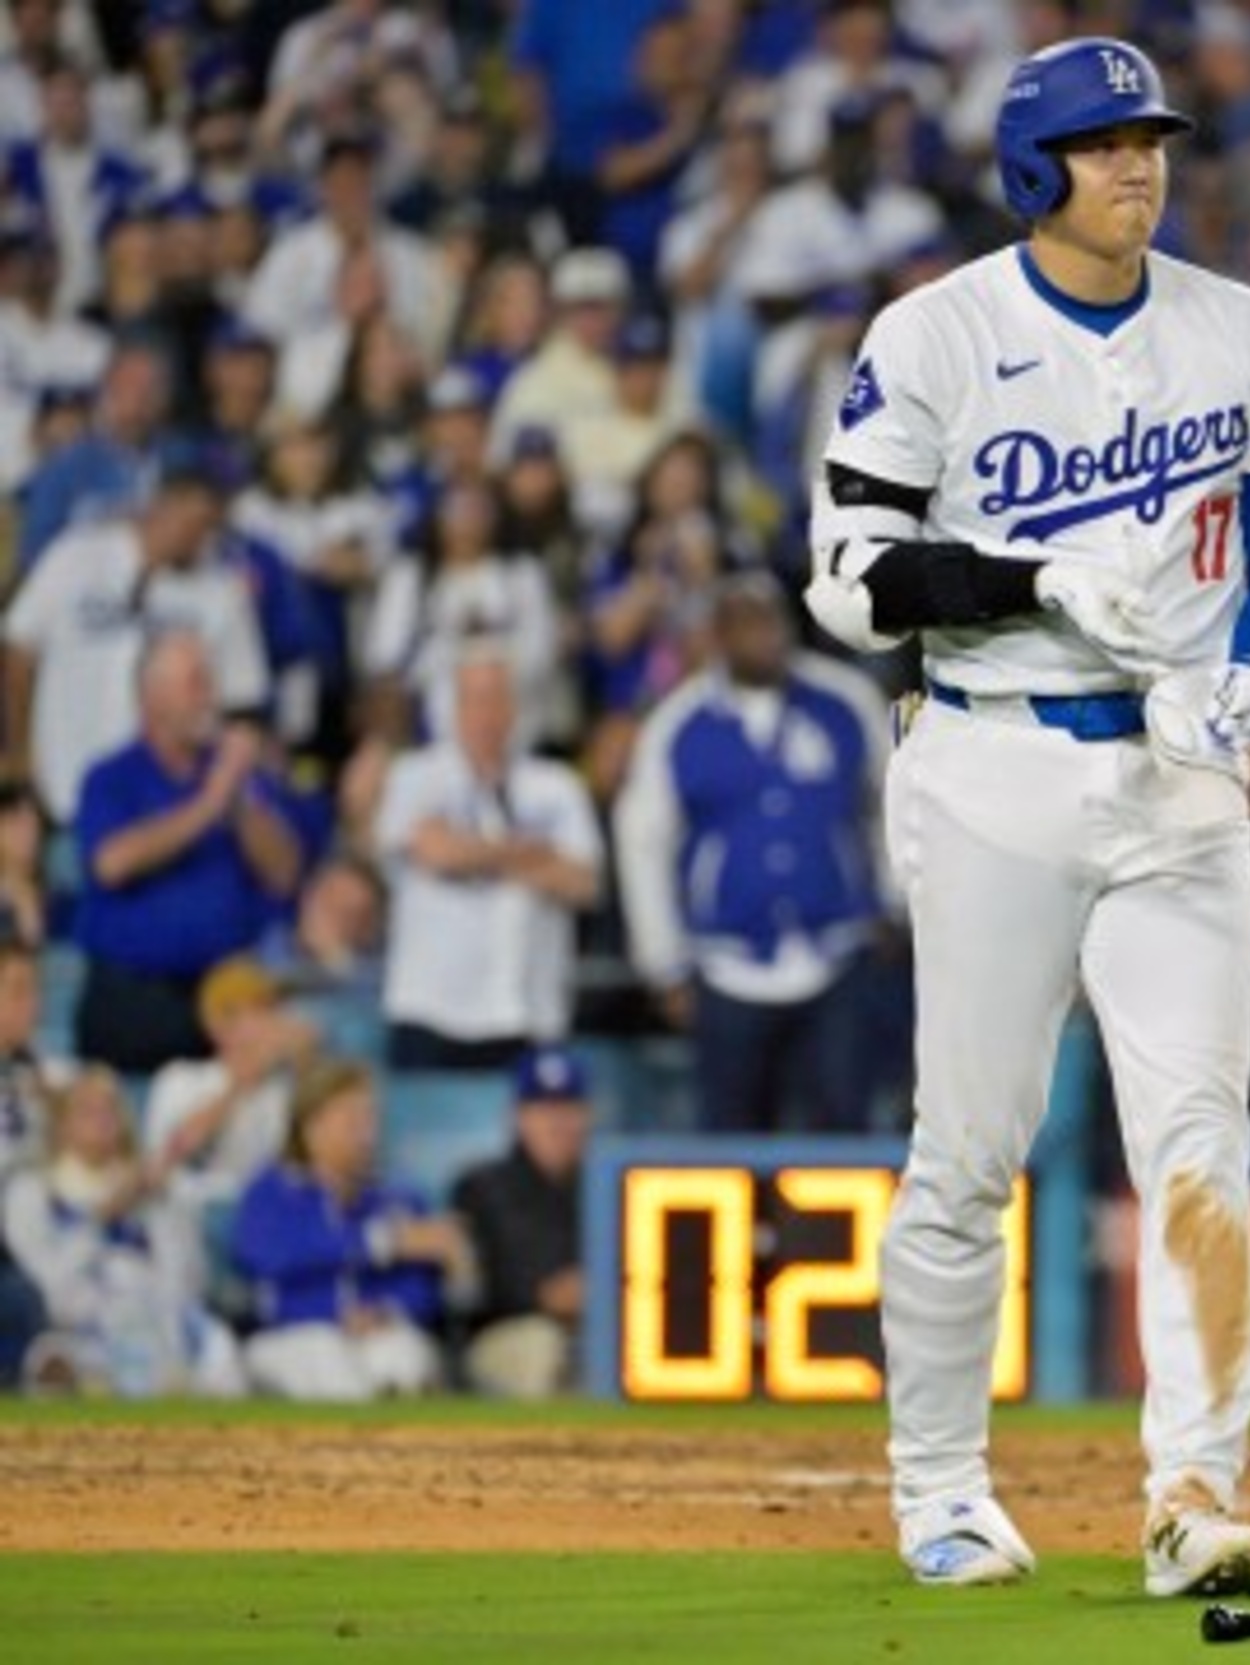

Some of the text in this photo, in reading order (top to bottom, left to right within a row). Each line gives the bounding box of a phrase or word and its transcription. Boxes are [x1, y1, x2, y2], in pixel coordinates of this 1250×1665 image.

[1099, 50, 1141, 93] LA
[974, 402, 1249, 525] Dodgers
[1192, 493, 1235, 582] 17
